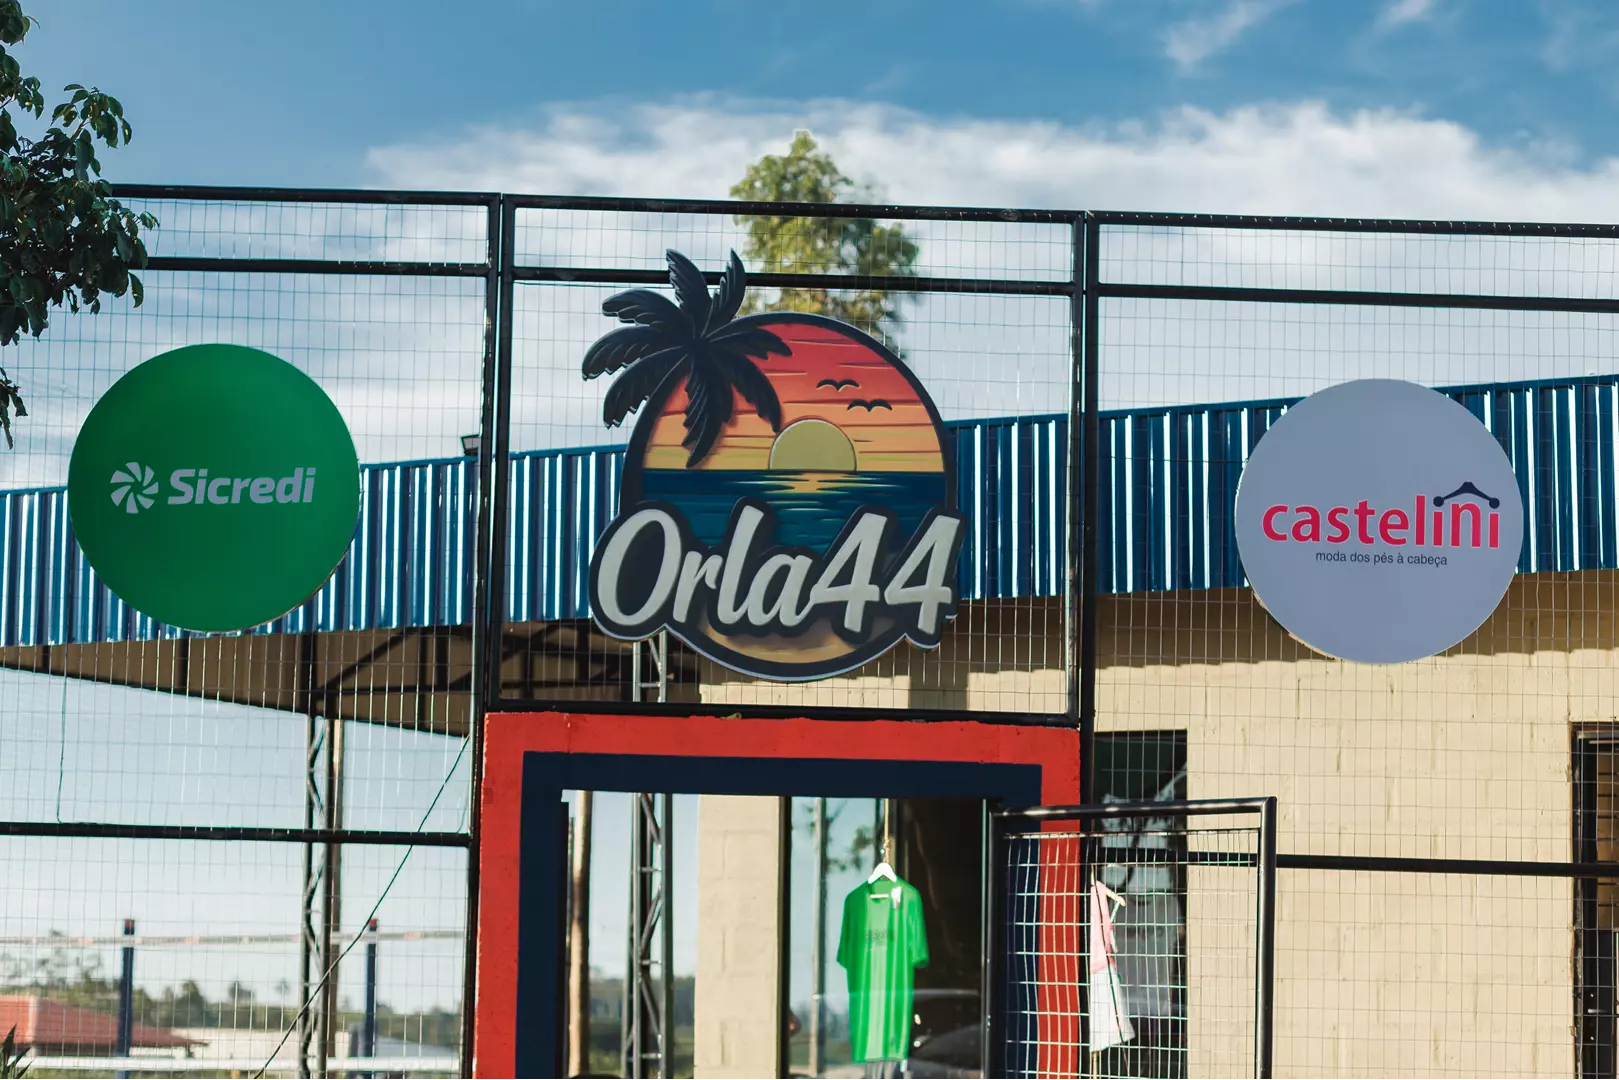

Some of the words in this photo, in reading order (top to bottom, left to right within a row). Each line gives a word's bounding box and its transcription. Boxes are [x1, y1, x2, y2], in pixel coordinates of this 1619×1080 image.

[167, 467, 316, 505] Sicredi
[1262, 494, 1500, 548] castelini
[597, 505, 961, 634] Orla44
[1315, 550, 1347, 563] moda
[1349, 552, 1371, 563] dos
[1373, 551, 1394, 566] pés
[1396, 552, 1404, 564] à
[1407, 553, 1448, 568] cabeça
